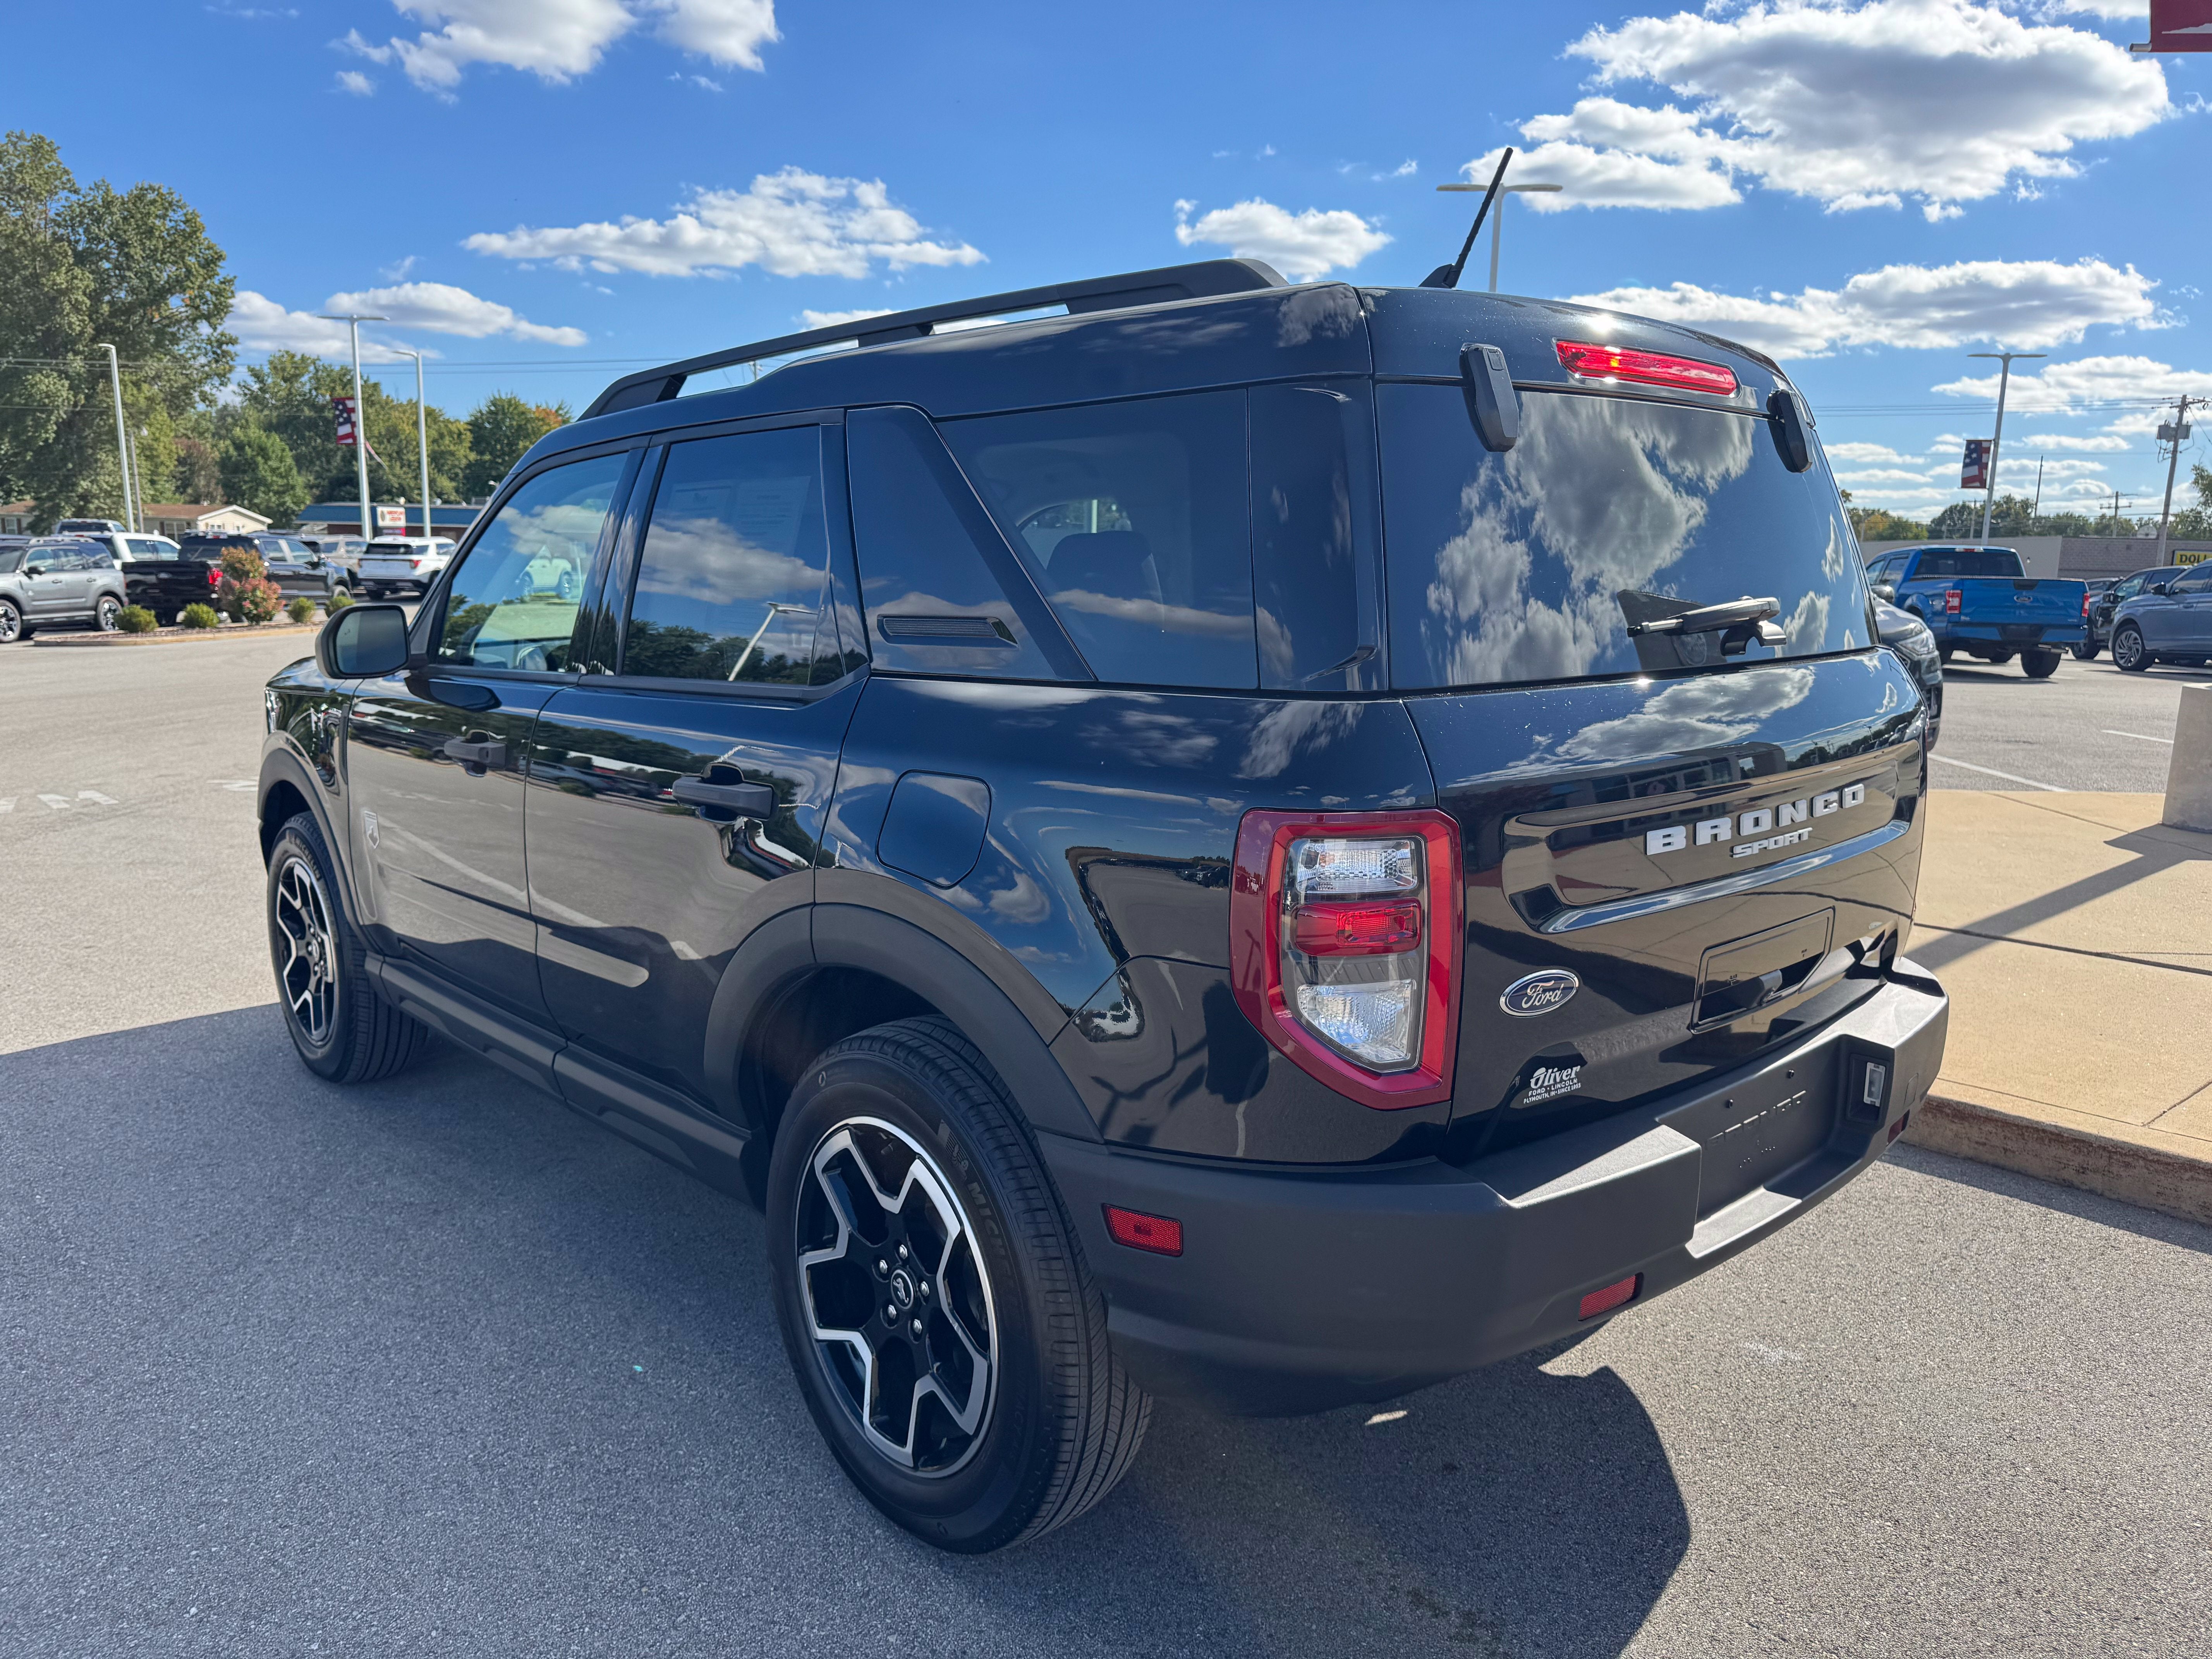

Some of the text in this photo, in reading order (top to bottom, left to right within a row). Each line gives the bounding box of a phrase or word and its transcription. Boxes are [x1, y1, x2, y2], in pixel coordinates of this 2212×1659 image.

[1645, 783, 1865, 855] BRONCO
[1731, 827, 1813, 858] SPORT
[1522, 980, 1564, 1008] Ford
[1528, 1078, 1577, 1097] FORD LINCOLN
[1530, 1065, 1581, 1089] Oliver
